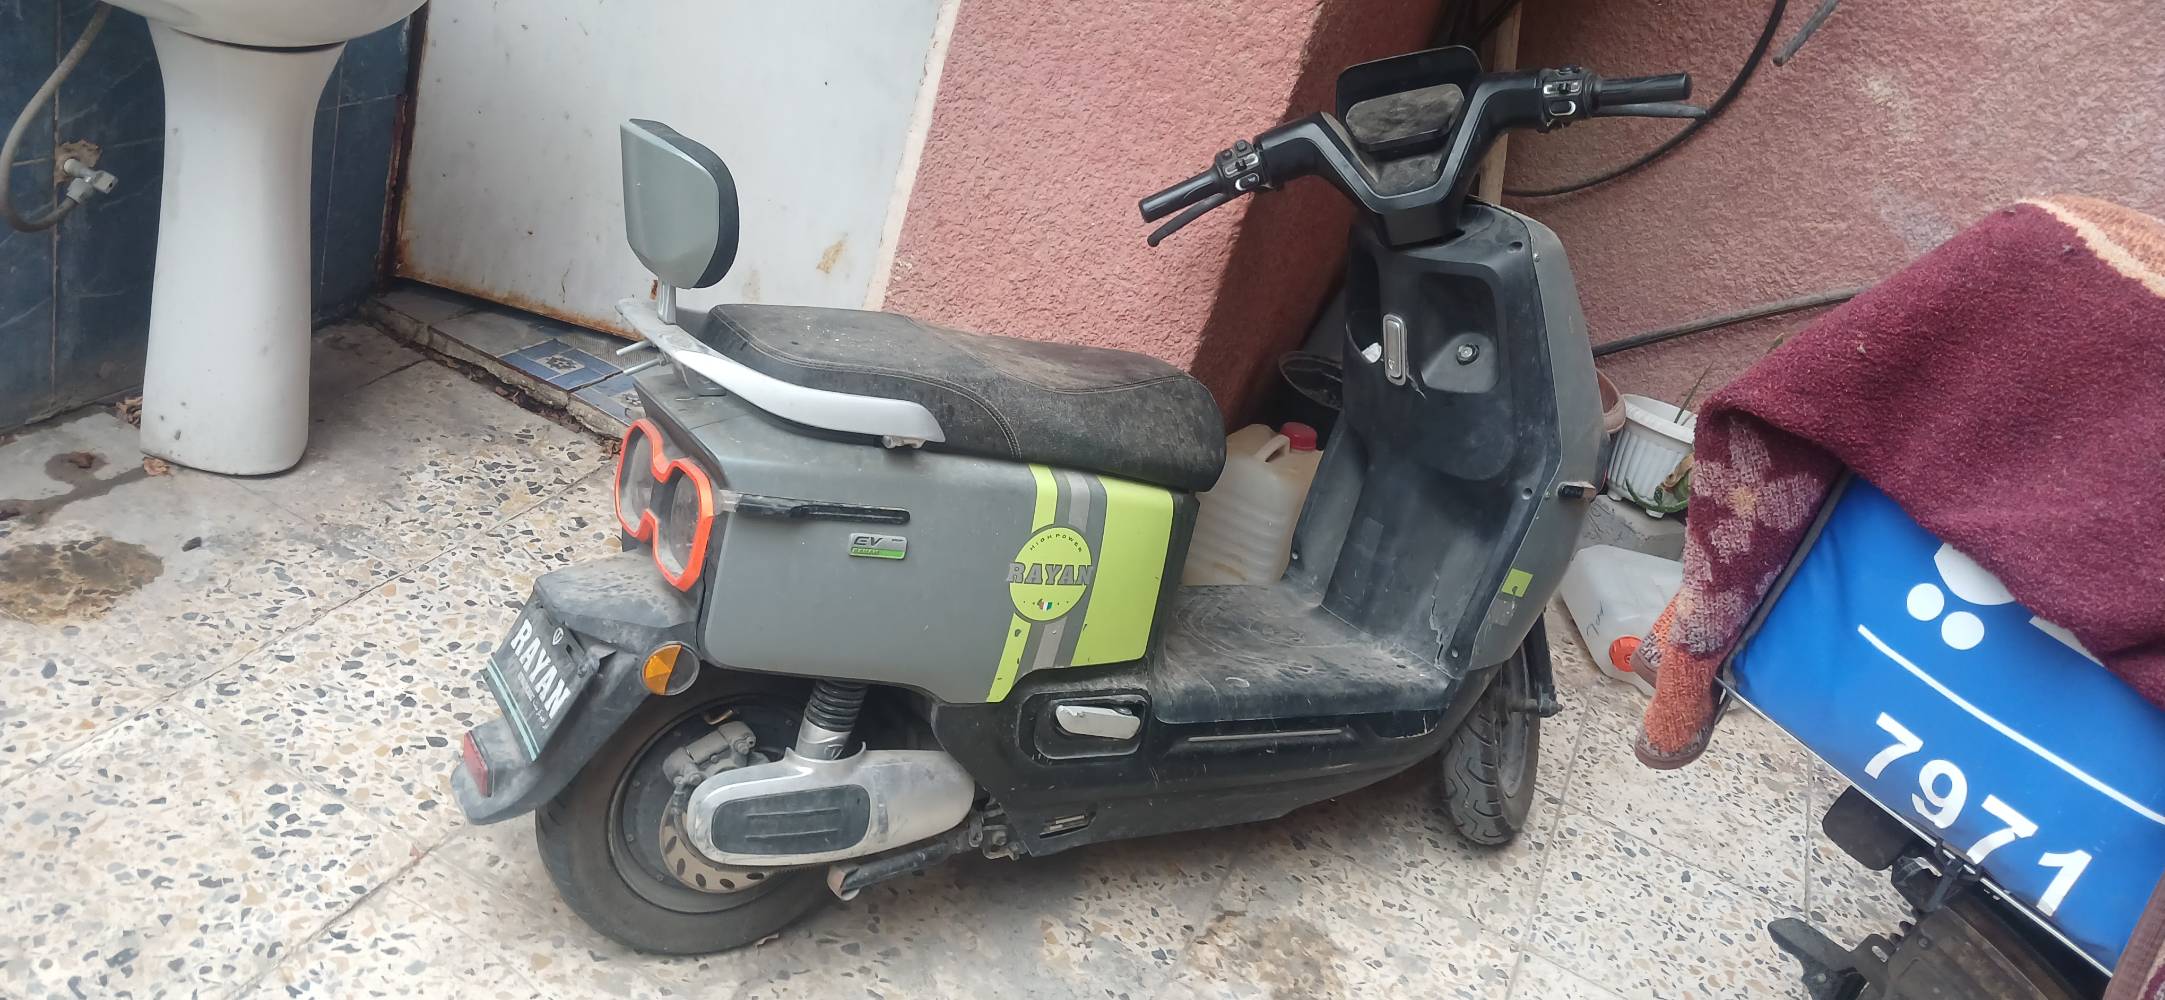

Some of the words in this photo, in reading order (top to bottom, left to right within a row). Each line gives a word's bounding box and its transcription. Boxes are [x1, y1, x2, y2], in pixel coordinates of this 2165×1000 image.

[854, 536, 883, 546] EV
[1055, 533, 1082, 553] POWER
[1007, 561, 1093, 585] RAYAN
[510, 618, 571, 720] RAYAN
[1864, 711, 2093, 917] 7971
